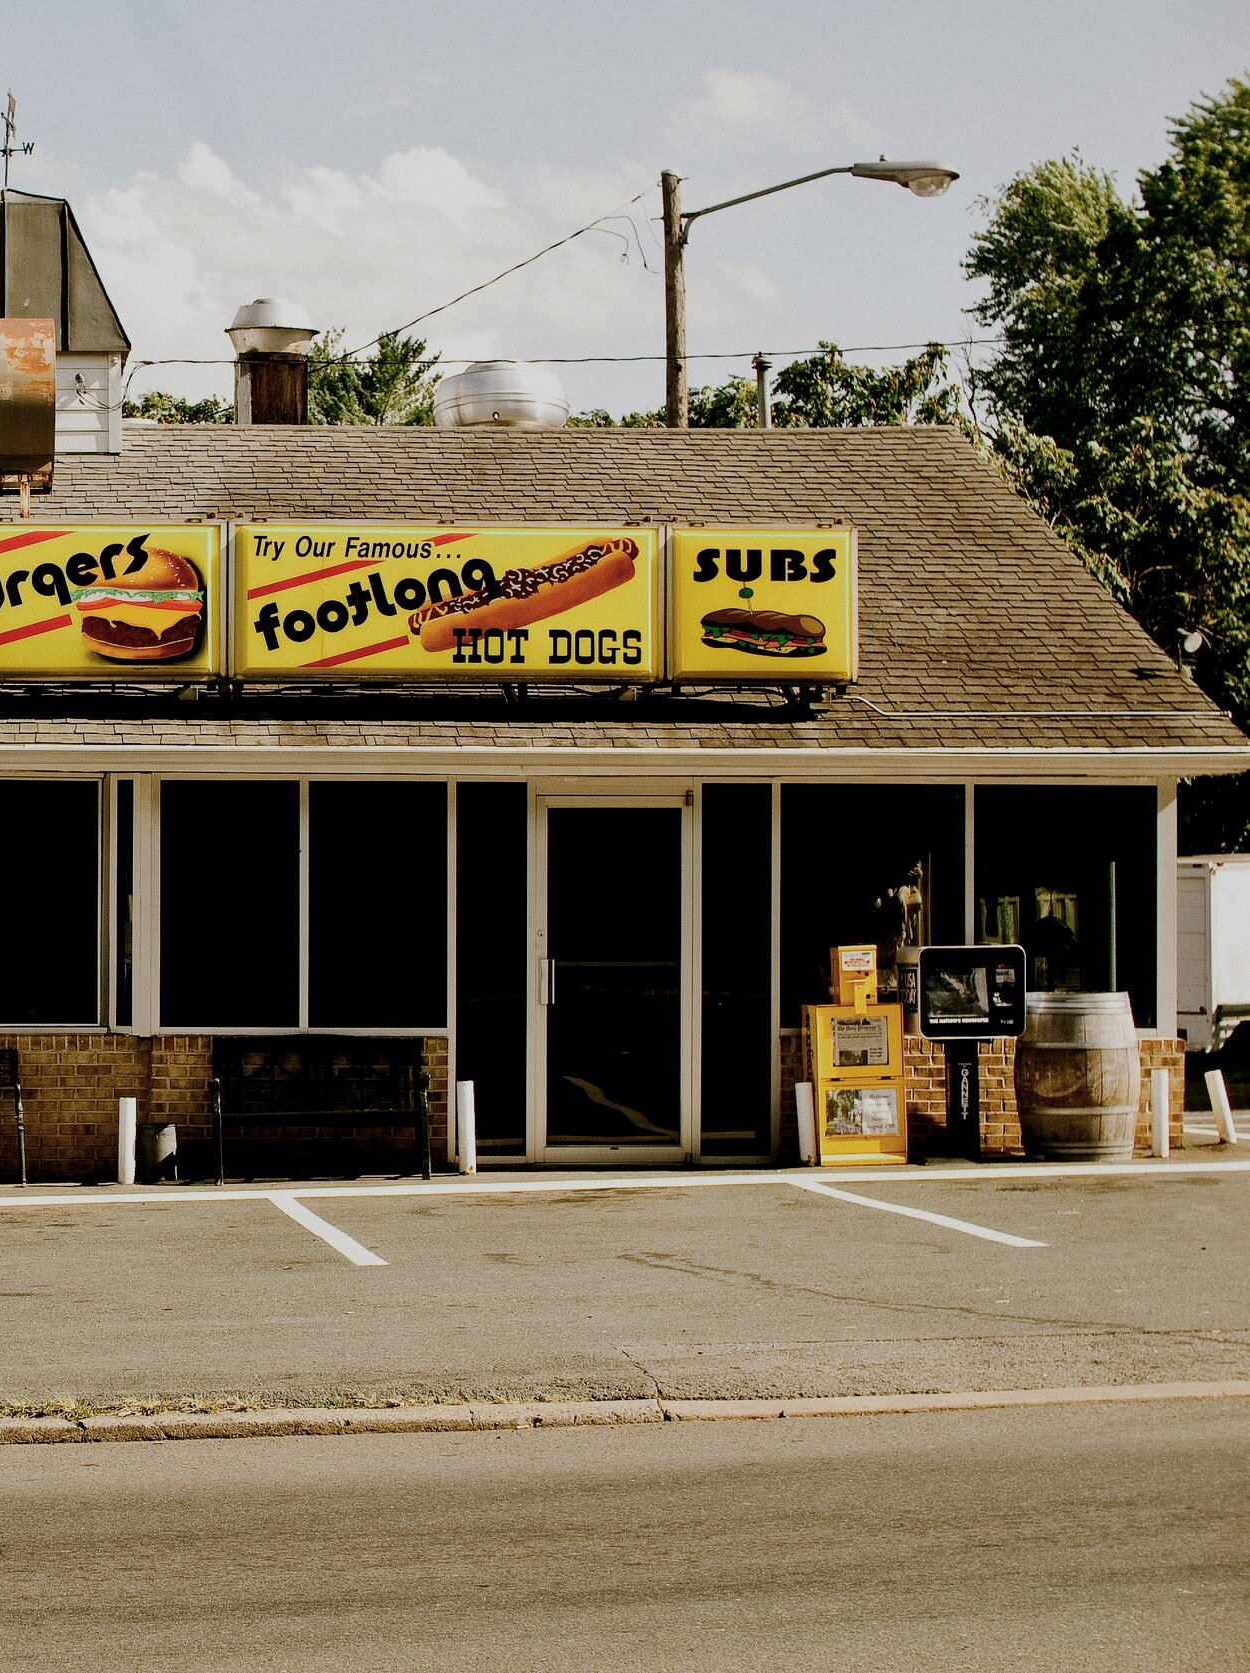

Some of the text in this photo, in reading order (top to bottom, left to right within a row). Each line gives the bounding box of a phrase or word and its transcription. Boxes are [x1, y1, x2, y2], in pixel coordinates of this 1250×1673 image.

[22, 142, 35, 155] W
[253, 535, 462, 560] Try Our Famous...
[693, 548, 837, 583] SUBS
[253, 558, 501, 652] footlong
[452, 628, 642, 665] HOT DOGS
[961, 1069, 969, 1120] GANNETT
